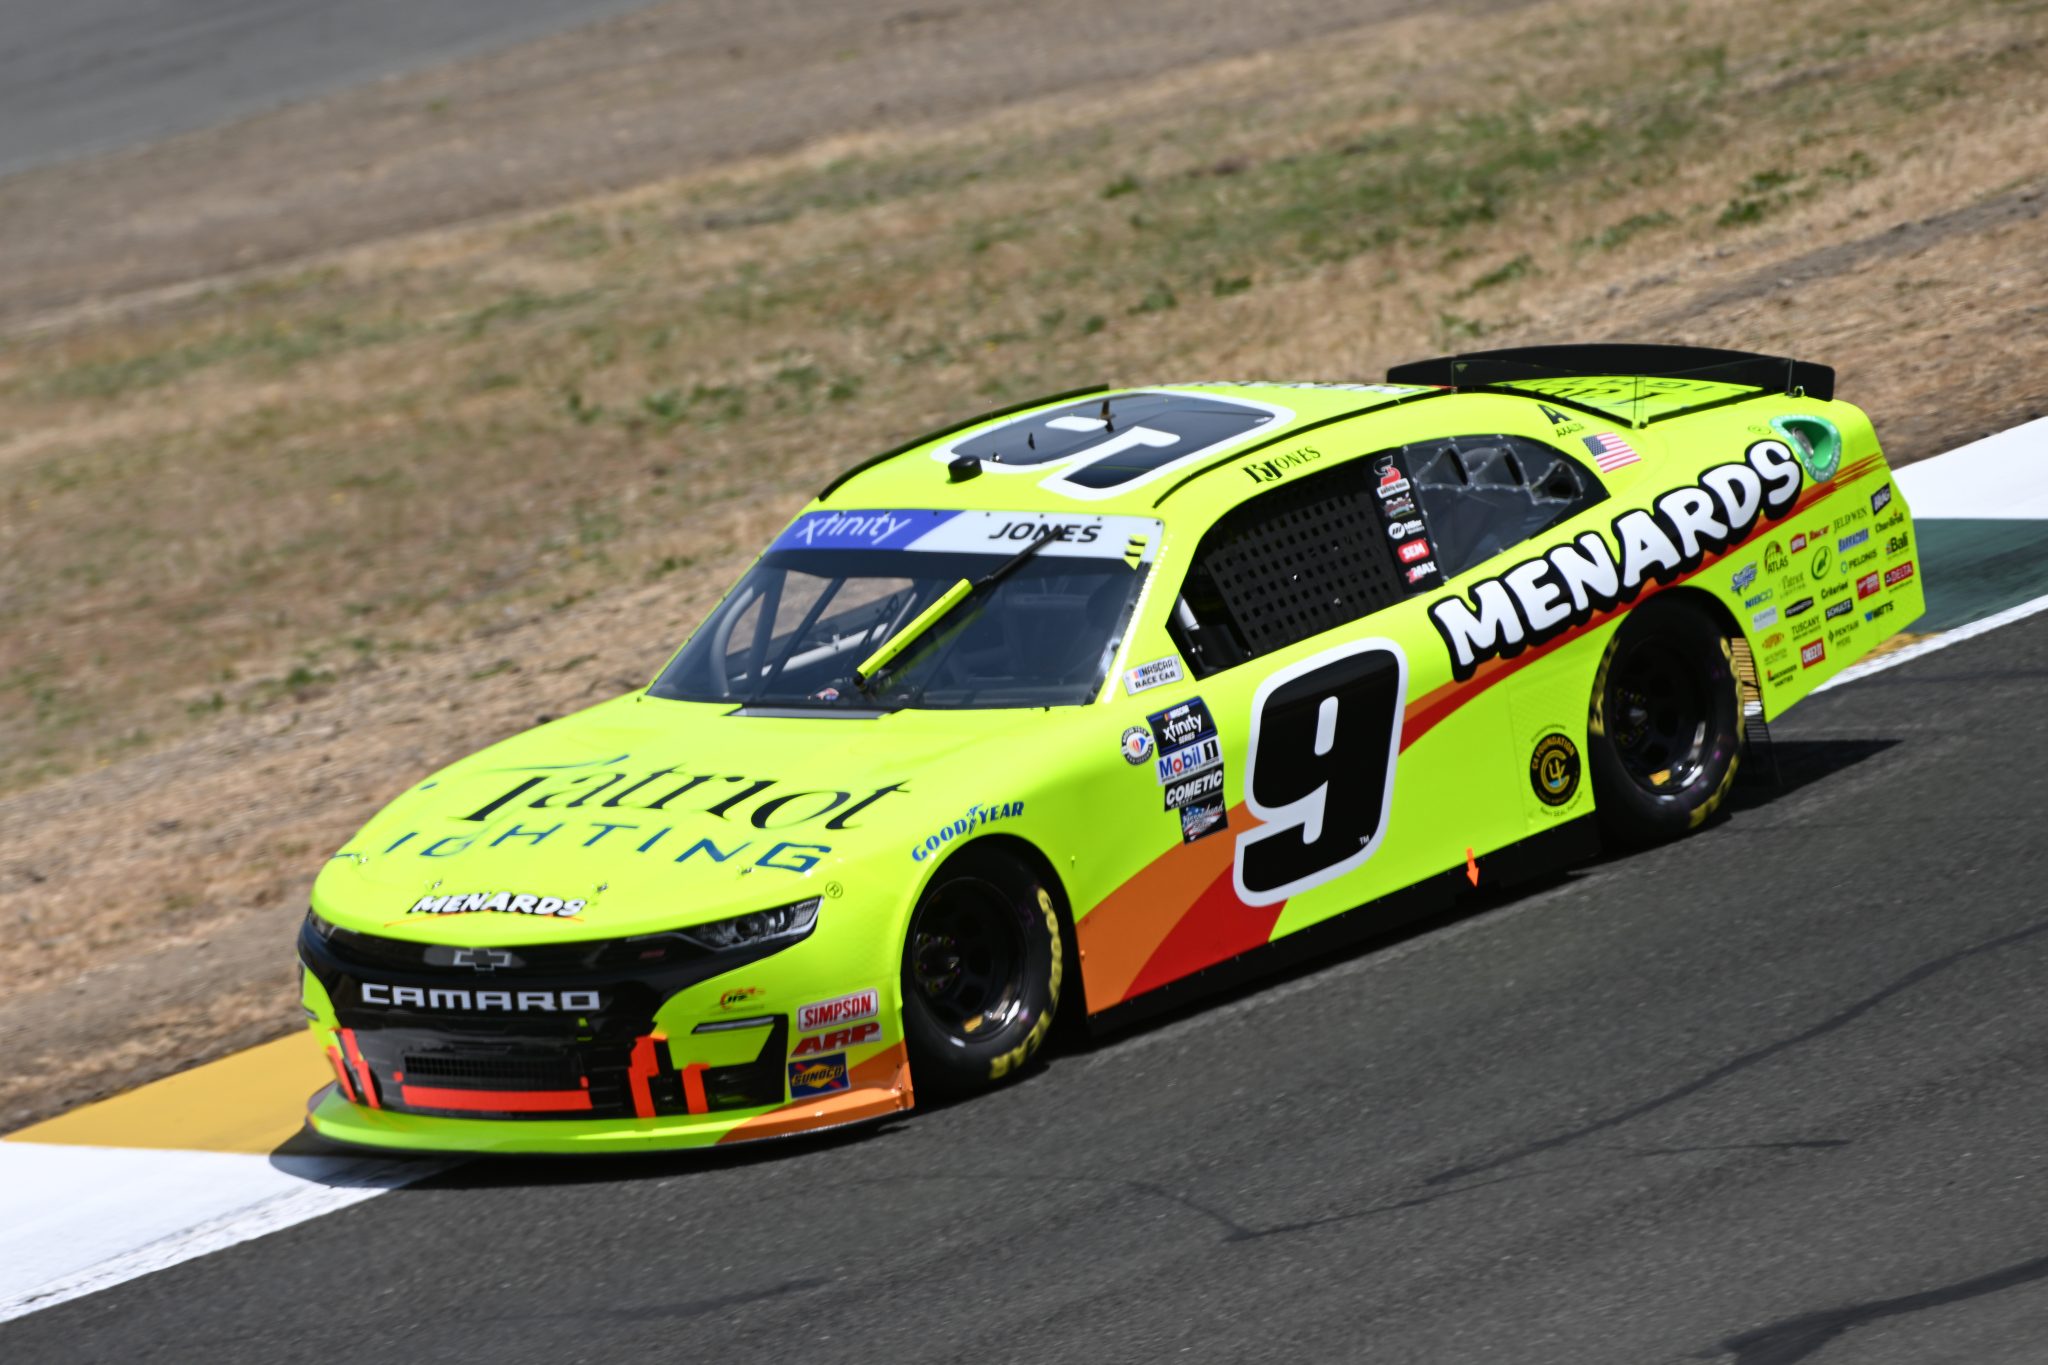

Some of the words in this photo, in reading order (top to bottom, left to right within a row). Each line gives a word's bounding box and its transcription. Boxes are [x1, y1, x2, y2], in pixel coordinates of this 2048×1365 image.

[795, 511, 912, 546] xfinity
[988, 522, 1103, 544] JONES
[1402, 542, 1426, 559] SEM
[1889, 531, 1909, 553] Bali
[1430, 440, 1802, 676] MENARDS
[1767, 555, 1789, 575] ATLAS
[1791, 615, 1820, 636] TUSCANY
[1135, 675, 1157, 689] RACE
[1159, 670, 1176, 683] CAR
[1141, 658, 1174, 677] NASCAR
[1163, 714, 1202, 743] xfinity
[1178, 732, 1196, 745] SERIES
[1159, 745, 1201, 779] Mobil
[1238, 645, 1403, 898] 9
[1166, 769, 1223, 806] COMETIC
[1359, 834, 1370, 845] TM
[406, 891, 587, 917] MENARDS
[361, 983, 600, 1011] CAMARO
[803, 994, 872, 1028] SIMPSON
[790, 1022, 880, 1057] ARP
[791, 1062, 845, 1088] SUNOCO
